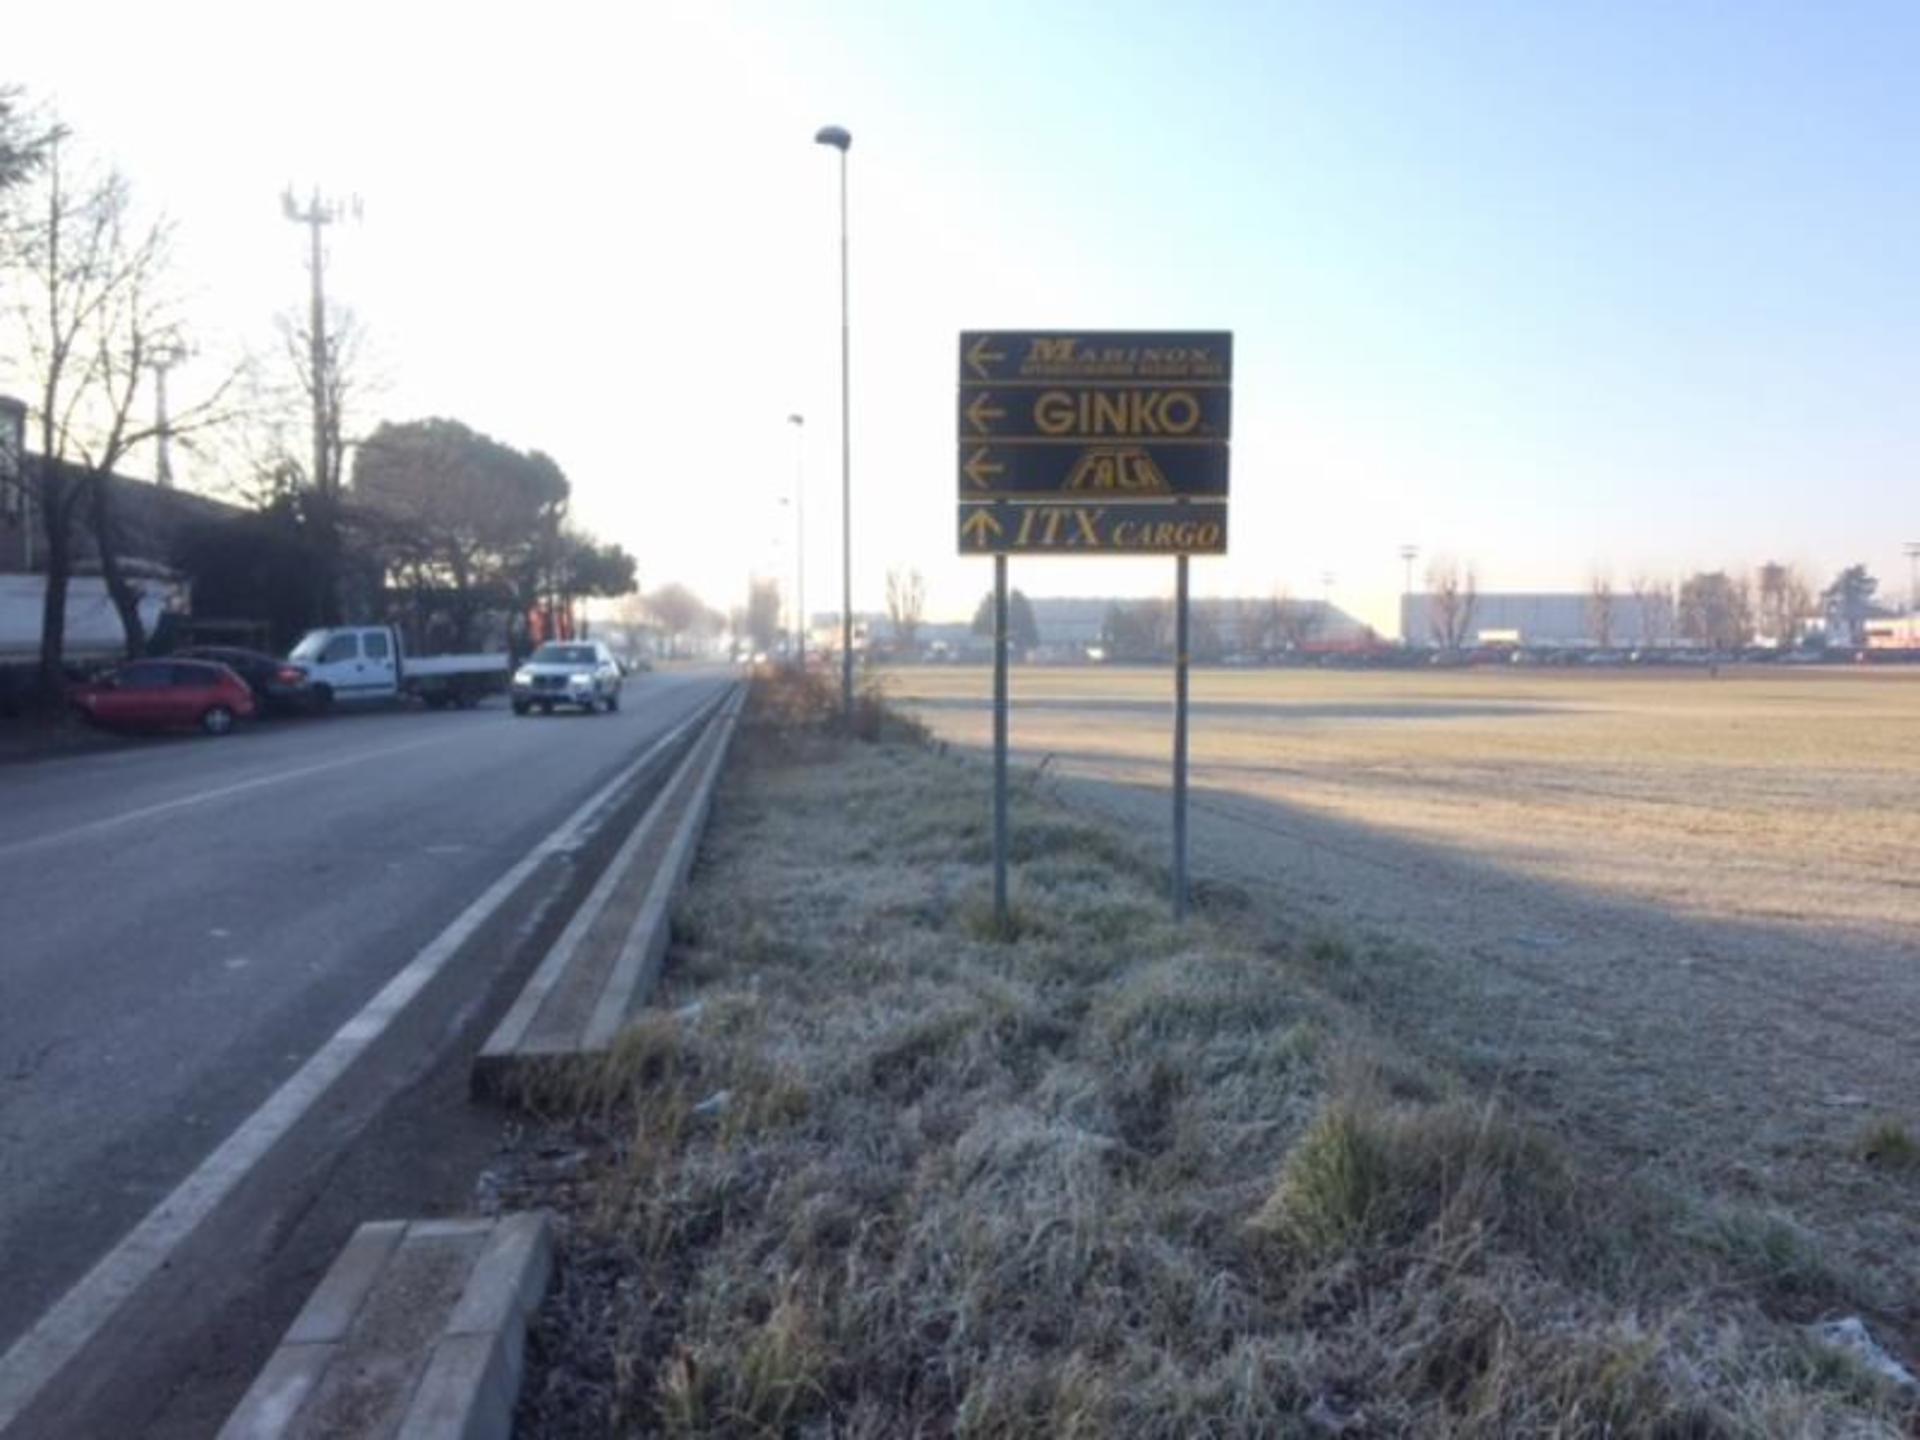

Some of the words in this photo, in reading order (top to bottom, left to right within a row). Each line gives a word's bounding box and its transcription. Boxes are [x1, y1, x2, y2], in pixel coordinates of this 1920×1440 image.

[1033, 391, 1200, 434] GINKO
[1014, 508, 1105, 545] ITX
[1112, 520, 1220, 546] CARGO
